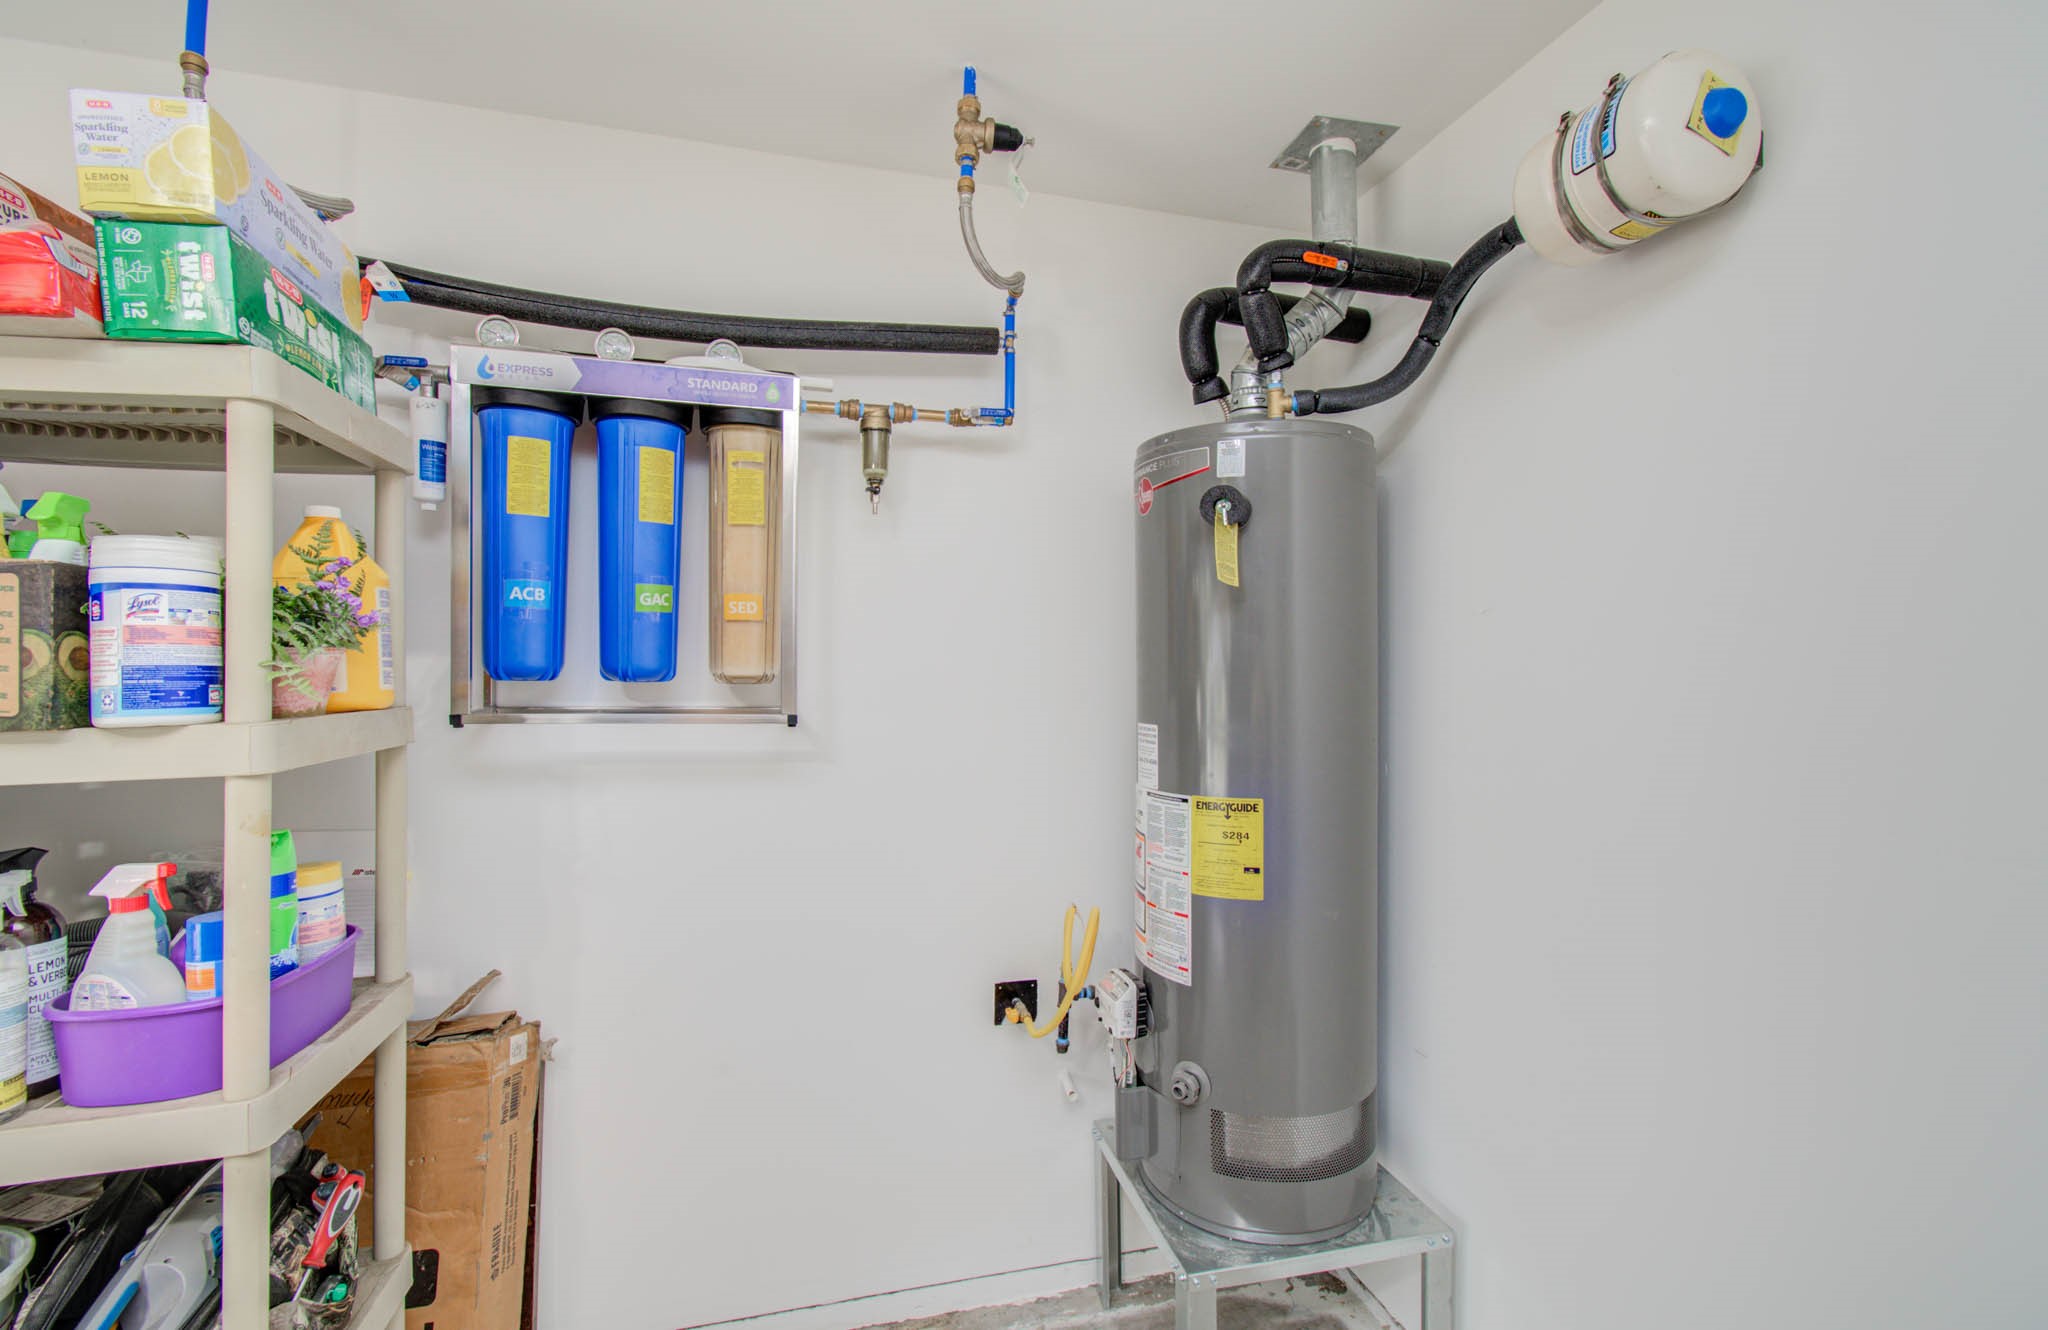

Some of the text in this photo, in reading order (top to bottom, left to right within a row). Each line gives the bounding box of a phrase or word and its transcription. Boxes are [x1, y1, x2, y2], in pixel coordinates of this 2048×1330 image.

[74, 121, 129, 135] Sparkling
[85, 132, 119, 142] Water
[84, 172, 129, 182] LEMON
[260, 188, 309, 250] Sparkling
[308, 236, 333, 270] Water
[131, 301, 148, 319] 12
[497, 363, 554, 377] EXPRESS
[687, 377, 759, 393] STANDARD
[508, 586, 546, 601] ACB
[639, 592, 670, 606] GAC
[127, 596, 161, 612] Lysol
[728, 600, 759, 615] SED
[1196, 801, 1259, 813] ENERGYGUIDE
[28, 957, 66, 975] LEMON
[28, 976, 39, 988] &
